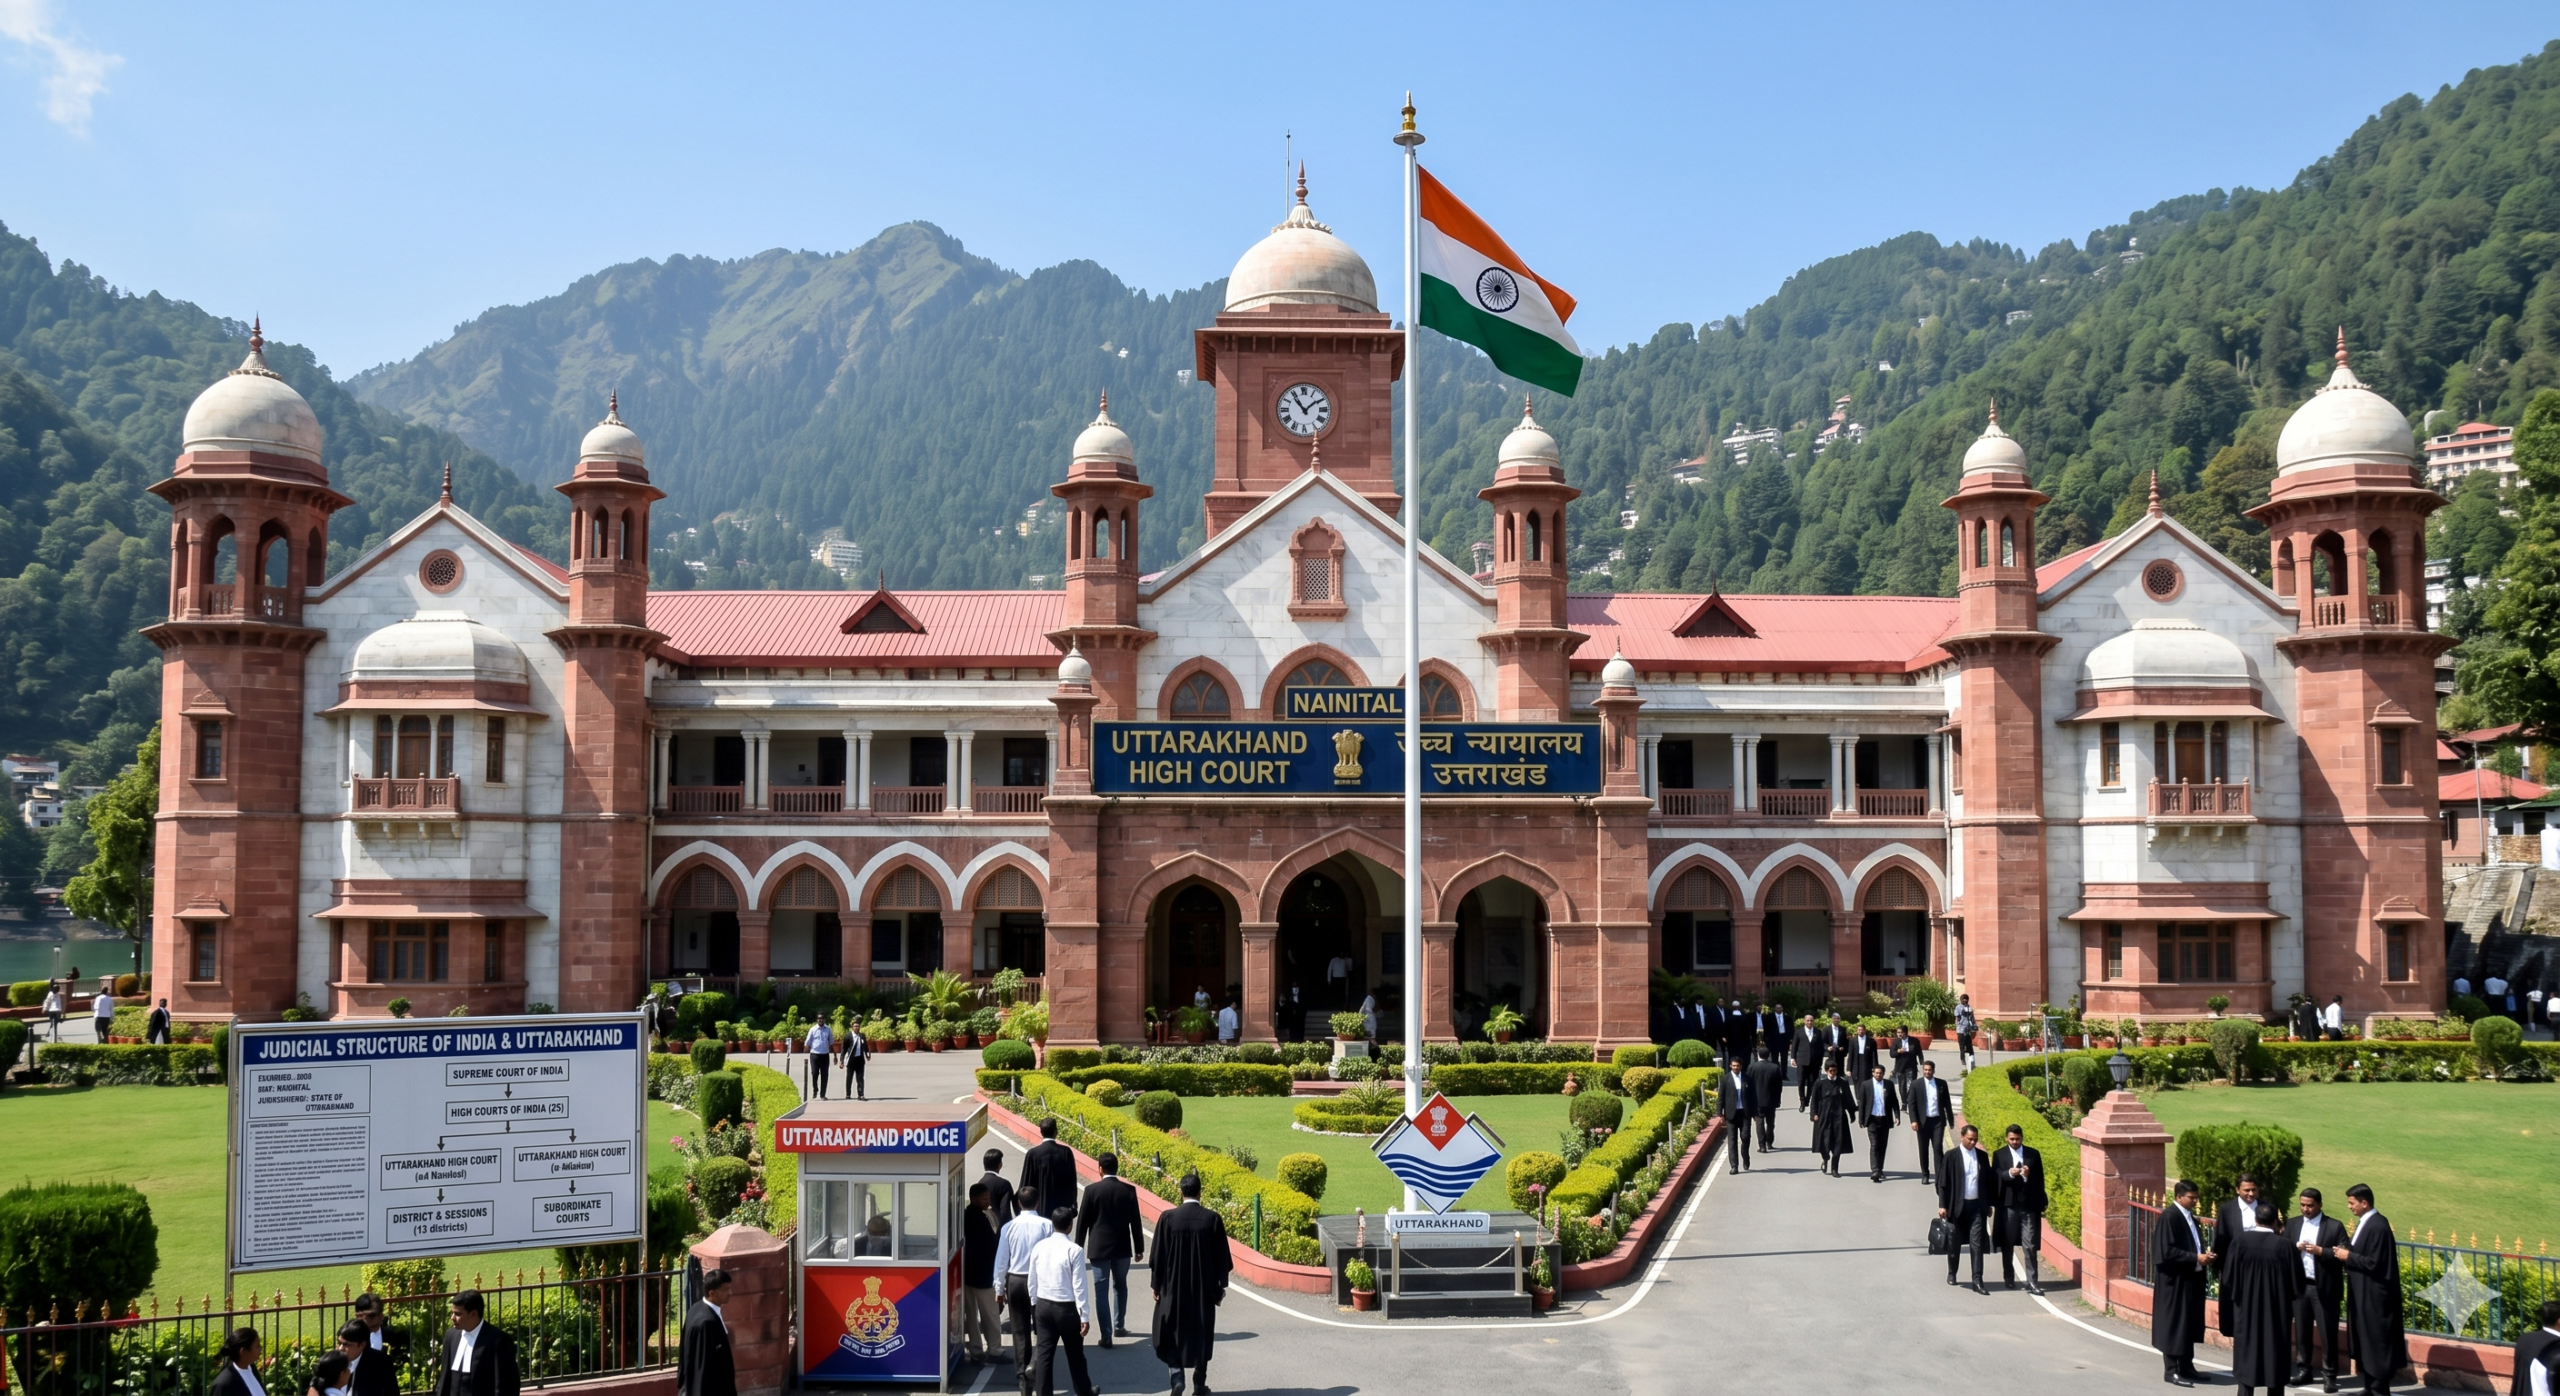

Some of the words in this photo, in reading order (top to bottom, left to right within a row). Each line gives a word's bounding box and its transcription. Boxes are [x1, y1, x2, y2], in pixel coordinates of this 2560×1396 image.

[1293, 692, 1403, 714] NAINITAL
[1112, 730, 1307, 754] UTTARAKHAND
[1464, 732, 1584, 755] न्यायालय
[1130, 760, 1192, 784] HIGH
[1201, 760, 1290, 784] COURT
[1430, 757, 1548, 786] उत्तराखंड
[259, 1039, 332, 1059] JUDICIAL
[336, 1035, 428, 1056] STRUCTURE
[432, 1034, 452, 1052] OF
[456, 1033, 497, 1051] INDIA
[501, 1032, 512, 1050] &
[516, 1028, 623, 1049] UTTARAKHAND
[453, 1068, 494, 1079] SUPREME
[496, 1067, 525, 1078] COURT
[527, 1066, 539, 1076] OF
[540, 1065, 564, 1075] INDIA
[311, 1093, 333, 1102] STATE
[334, 1093, 343, 1101] OF
[451, 1107, 472, 1117] HIGH
[474, 1105, 508, 1116] COURTS
[510, 1104, 521, 1114] OF
[523, 1103, 546, 1113] INDIA
[548, 1102, 564, 1114] (25)
[782, 1127, 899, 1147] UTTARAKHAND
[903, 1127, 959, 1147] POLICE
[385, 1158, 446, 1171] UTTARAKHAND
[447, 1156, 468, 1167] HIGH
[470, 1154, 498, 1165] COURT
[518, 1149, 578, 1162] UTTARAKHAND
[579, 1148, 599, 1159] HIGH
[600, 1147, 627, 1157] COURT
[393, 1211, 433, 1224] DISTRICT
[435, 1211, 442, 1220] &
[444, 1208, 488, 1219] SESSIONS
[556, 1212, 590, 1224] COURTS
[1395, 1218, 1483, 1230] UTTARAKHAND
[413, 1225, 428, 1236] (13
